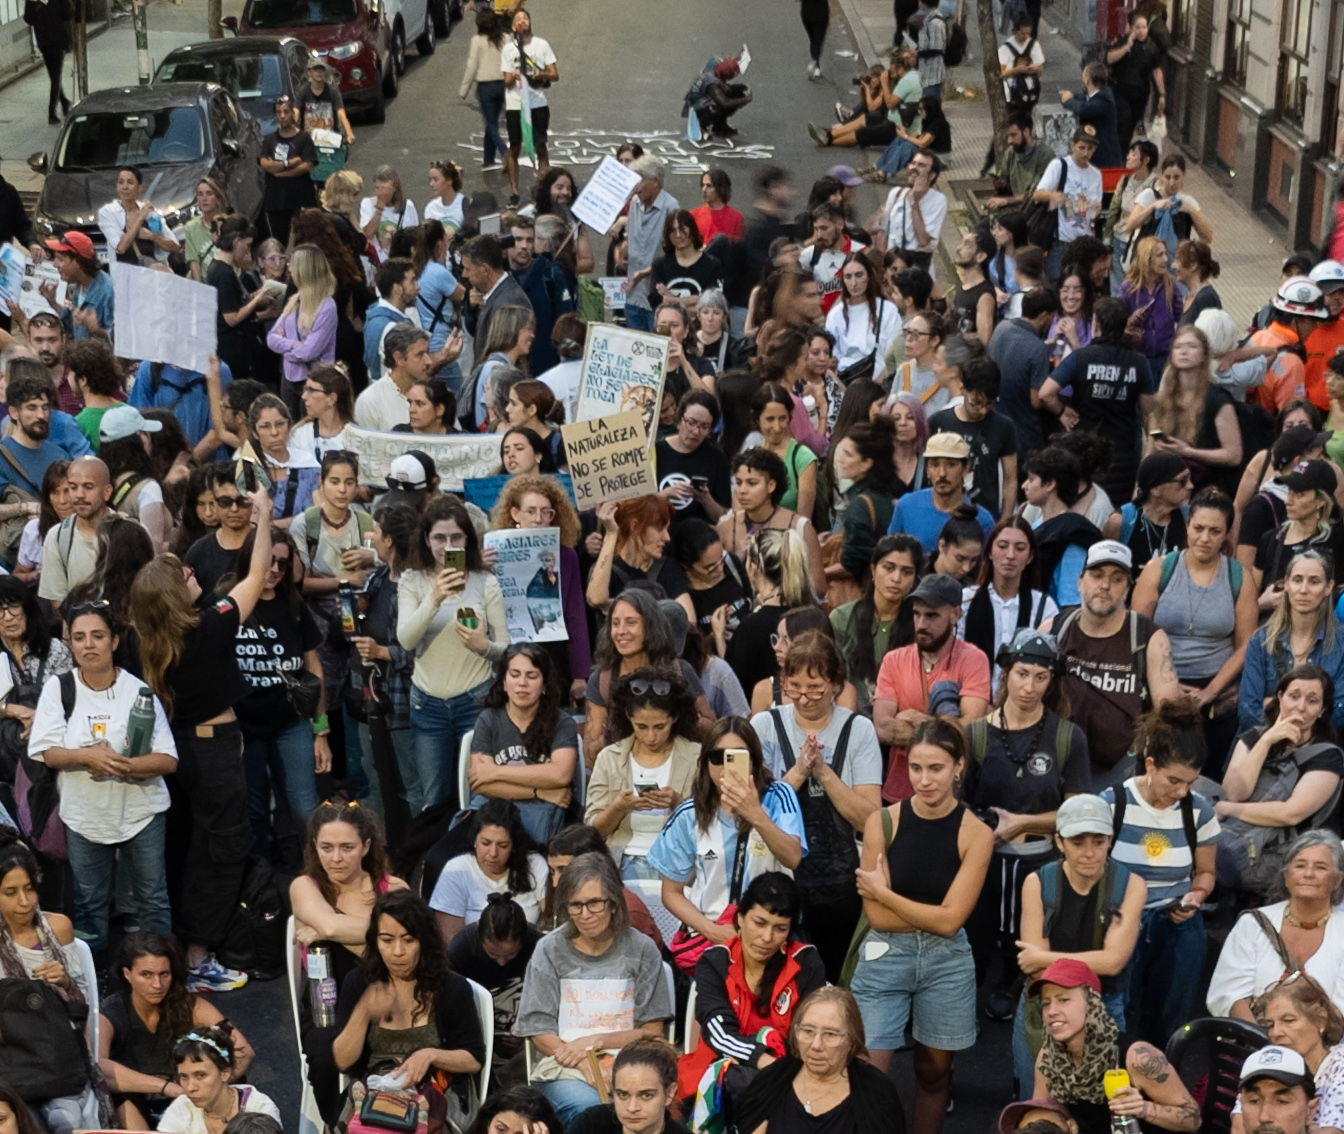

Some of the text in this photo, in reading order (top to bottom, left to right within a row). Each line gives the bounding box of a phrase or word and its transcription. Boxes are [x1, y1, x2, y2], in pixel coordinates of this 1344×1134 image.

[617, 354, 633, 369] DE
[586, 374, 622, 392] NO SE
[588, 418, 608, 433] LA
[567, 425, 638, 459] NATURALEZA
[570, 446, 647, 480] NO SE ROMPE
[577, 483, 592, 500] SE
[599, 470, 647, 497] PROTEGE
